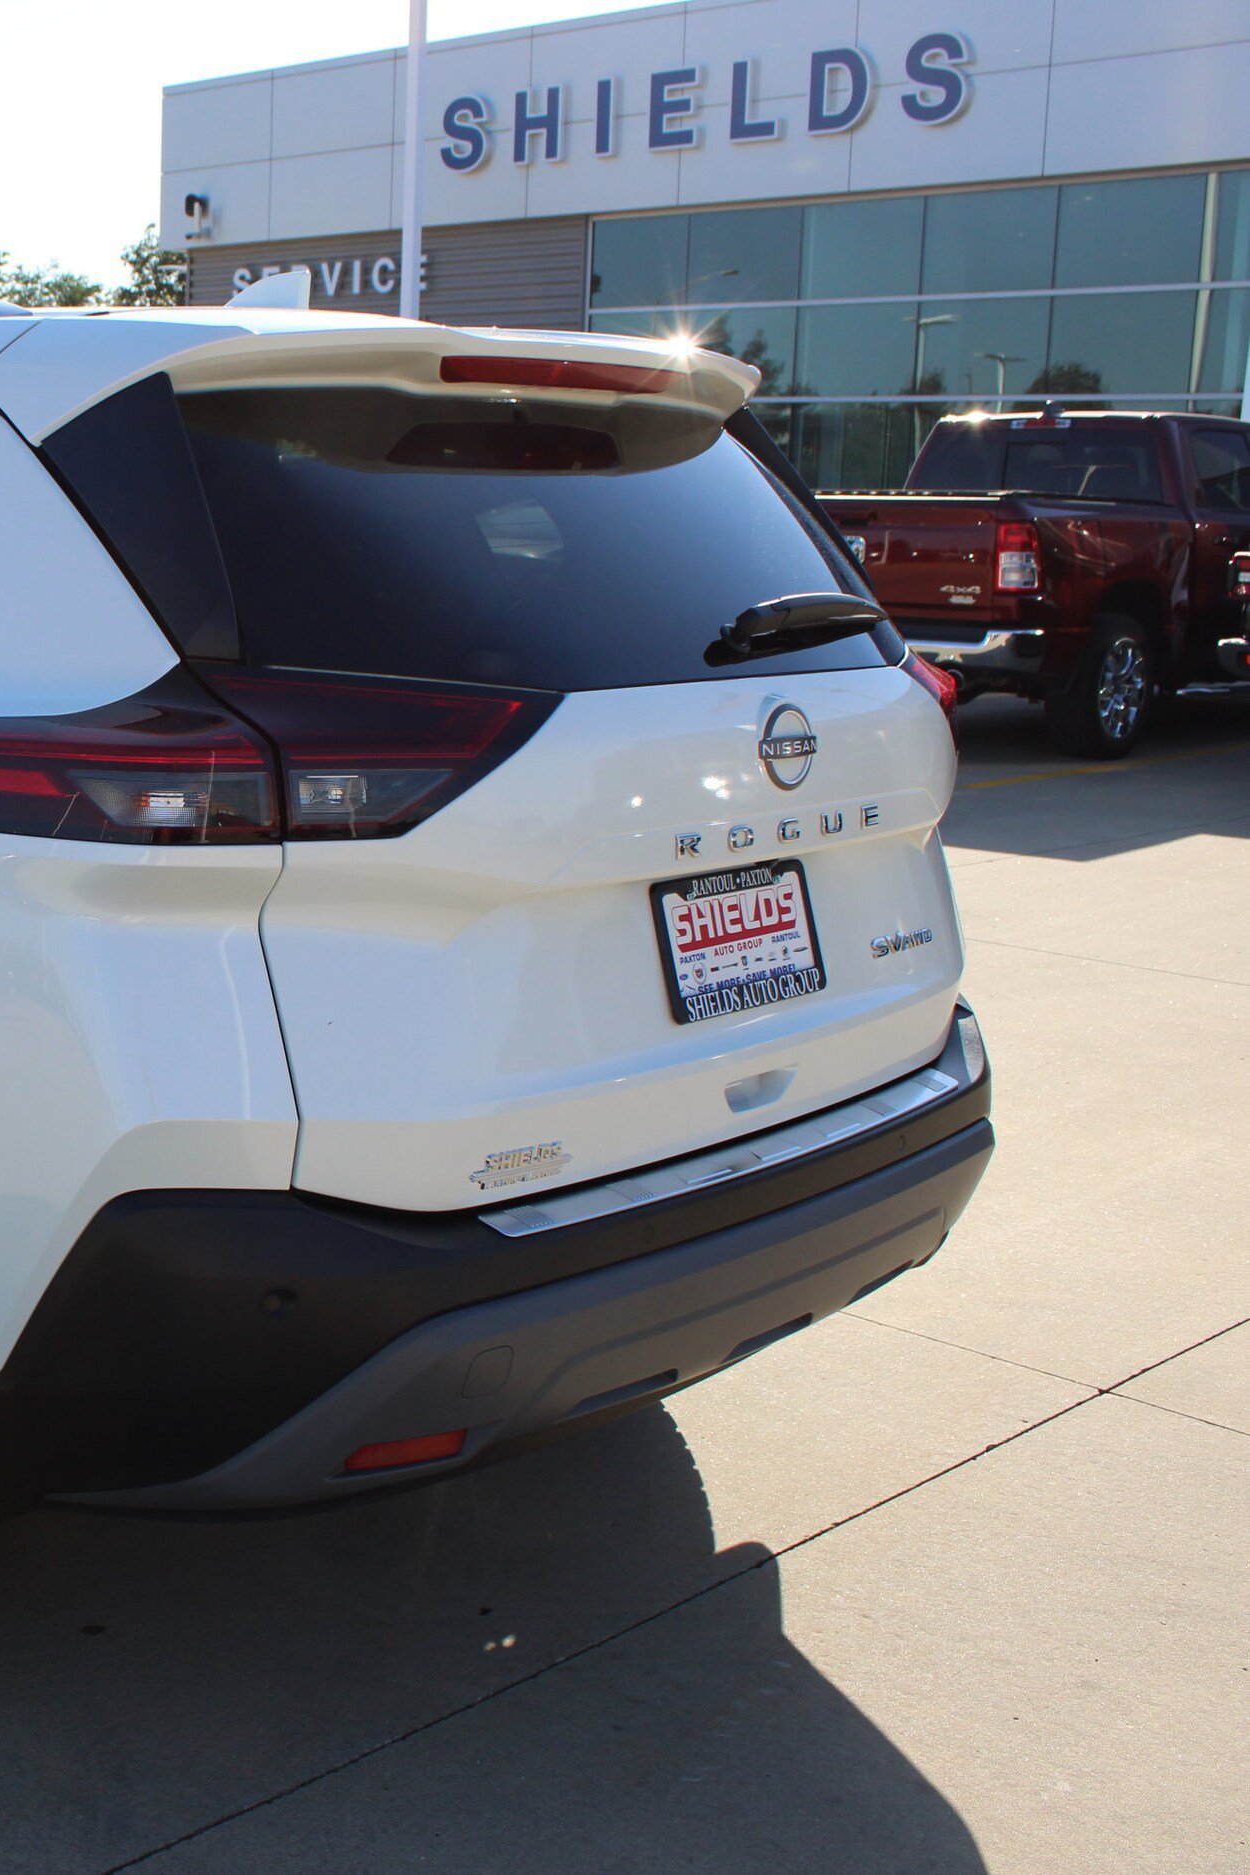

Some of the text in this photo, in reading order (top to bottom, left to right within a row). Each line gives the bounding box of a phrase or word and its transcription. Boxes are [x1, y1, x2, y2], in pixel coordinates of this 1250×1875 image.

[440, 30, 972, 174] SHIELDS
[232, 253, 428, 298] SVIC
[939, 584, 982, 594] 4x4
[761, 738, 817, 757] NISSAN
[675, 803, 879, 860] ROGUE
[691, 867, 772, 897] RANTOUL PAXTON
[671, 883, 798, 953] SHIELDS
[713, 938, 763, 957] AUTO GROUP
[771, 931, 801, 944] RANTOUL
[679, 952, 707, 965] PAXTON
[686, 967, 822, 1023] SHIELDS AUTO GROUP
